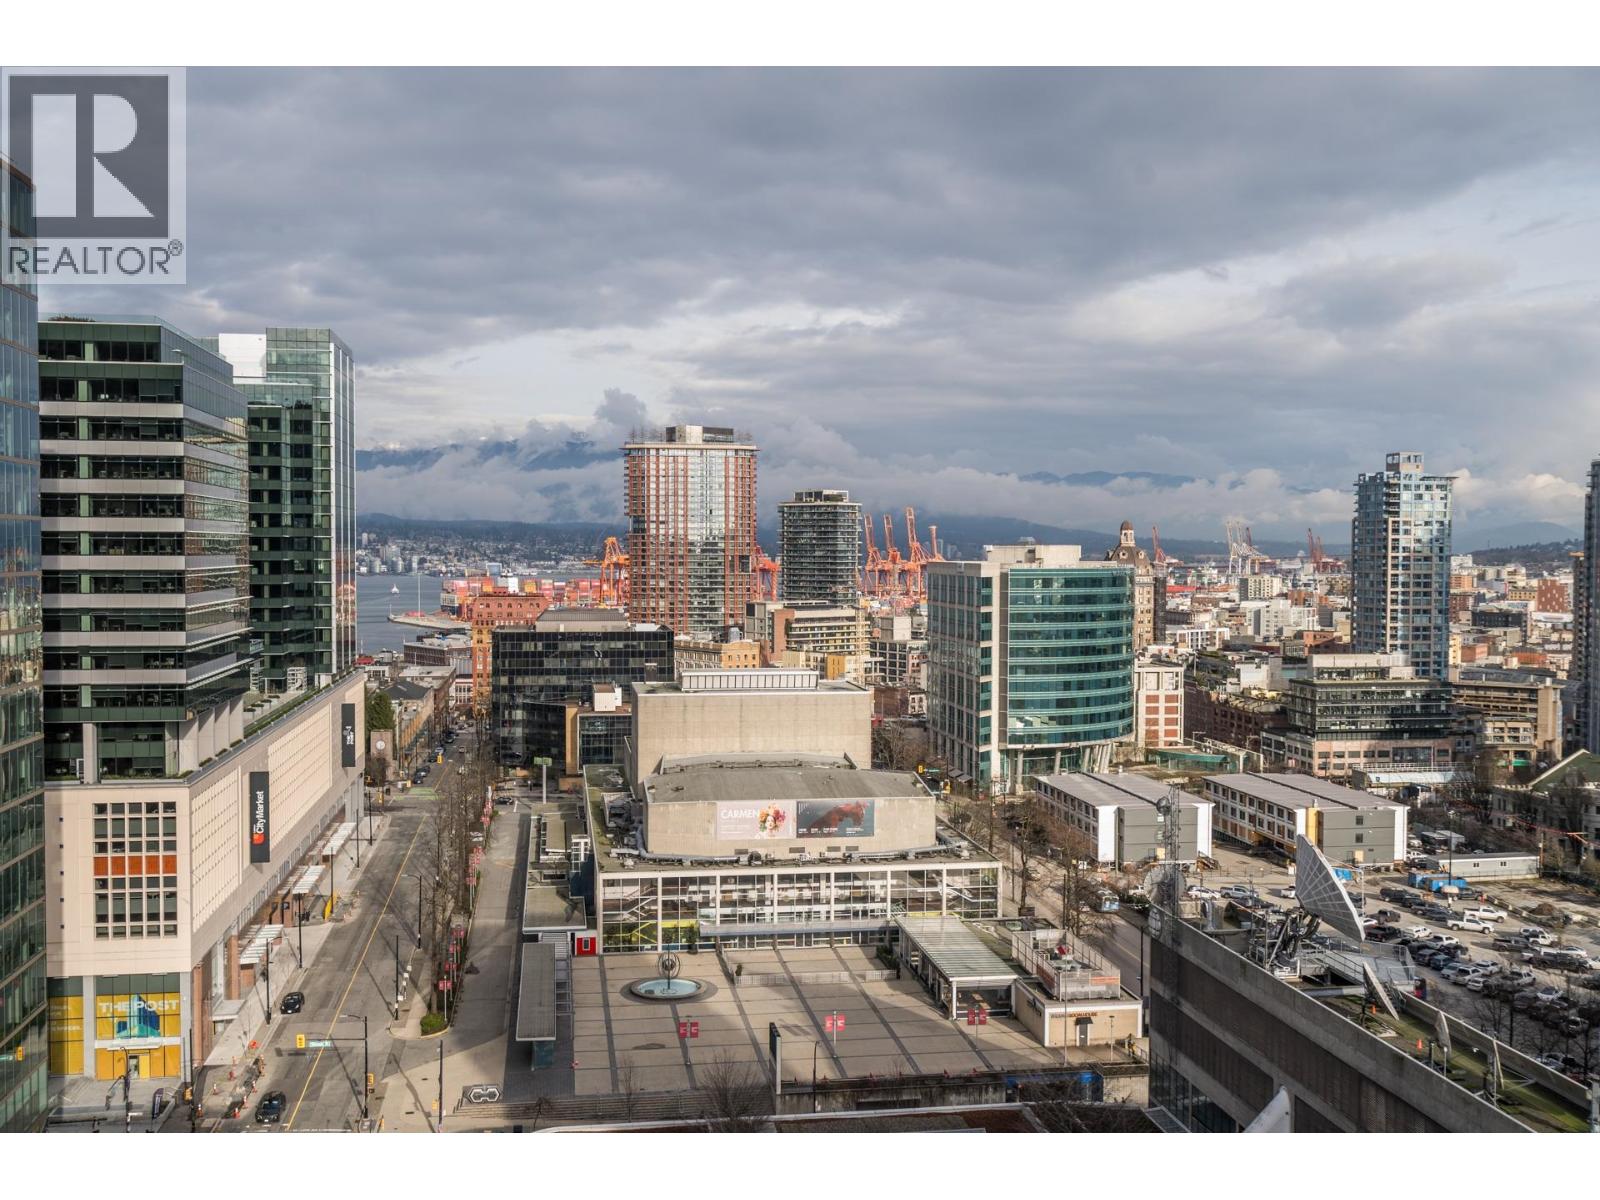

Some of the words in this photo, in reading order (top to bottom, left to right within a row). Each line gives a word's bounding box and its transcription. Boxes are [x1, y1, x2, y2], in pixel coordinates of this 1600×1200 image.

[720, 808, 760, 819] CARMEN
[98, 1002, 130, 1012] THE
[135, 999, 178, 1012] POST
